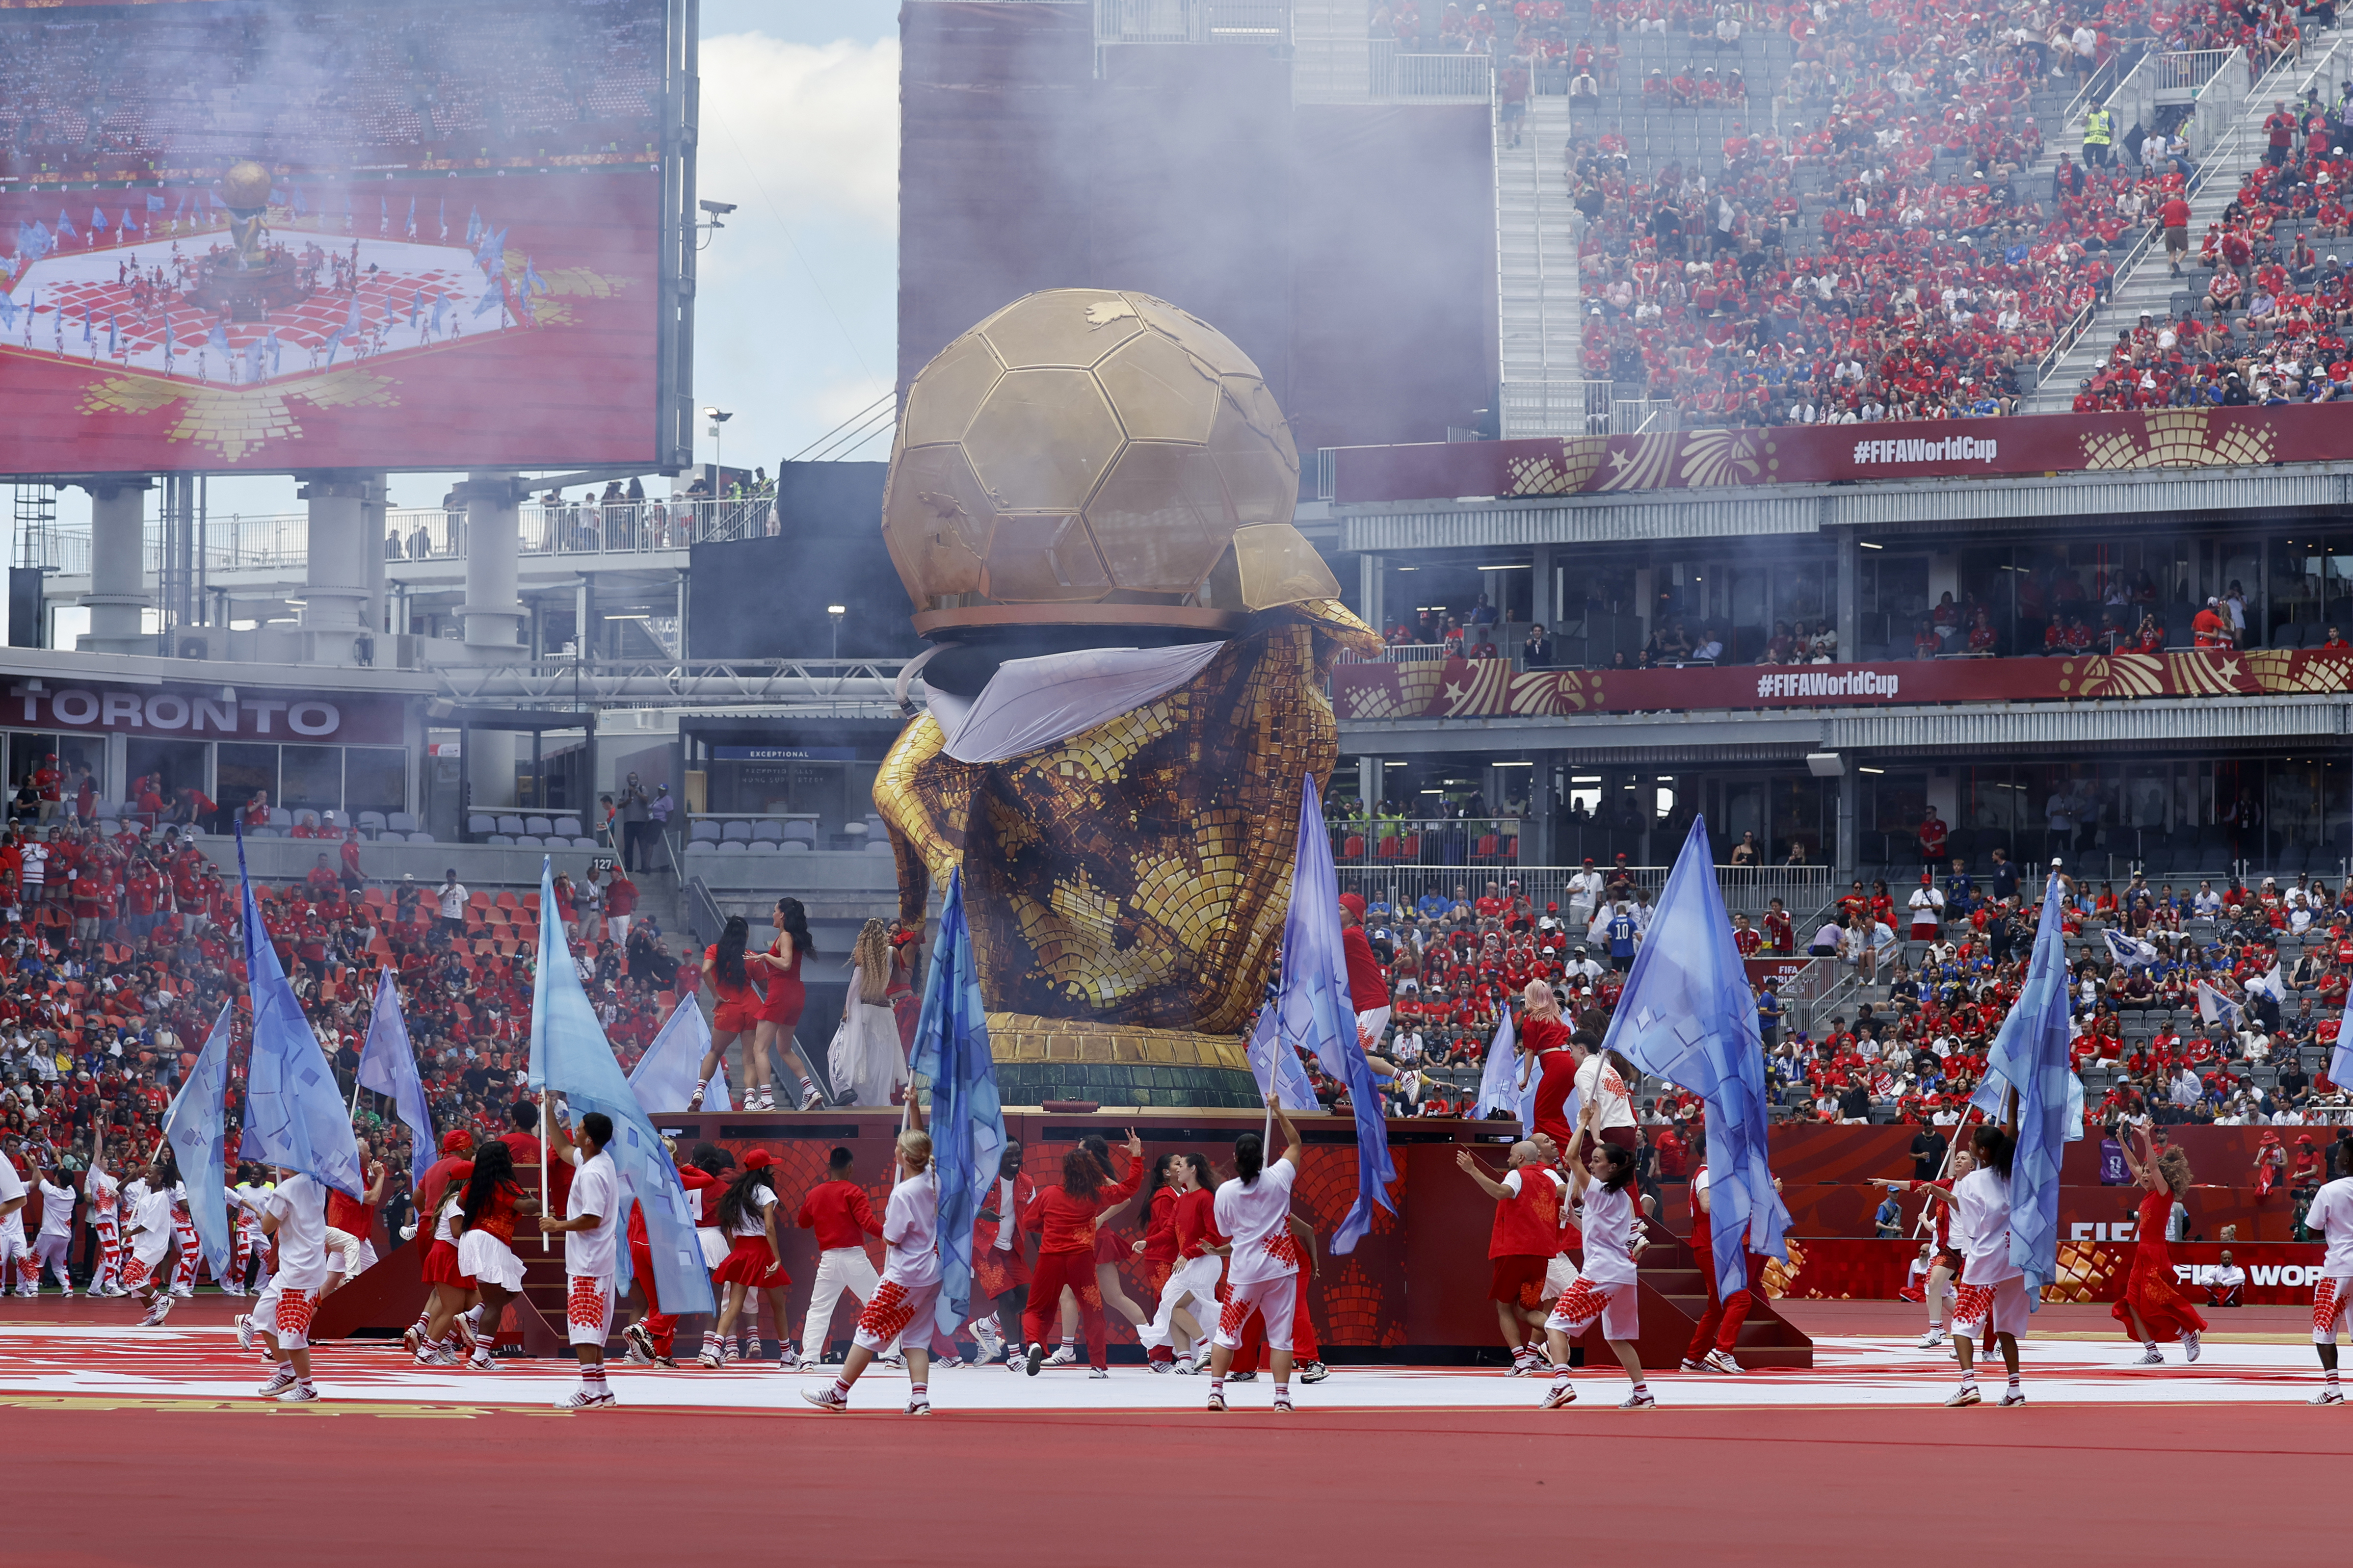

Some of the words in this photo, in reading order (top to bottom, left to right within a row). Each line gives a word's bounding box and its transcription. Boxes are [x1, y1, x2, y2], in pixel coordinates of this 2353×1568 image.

[1853, 436, 1997, 464] #FIFAWorldCup
[1757, 671, 1899, 698] #FIFAWorldCup
[10, 686, 340, 736] TORONTO
[594, 859, 612, 869] 127
[1615, 923, 1629, 940] 10
[1779, 966, 1798, 974] FIFA
[2071, 1223, 2140, 1241] FIF
